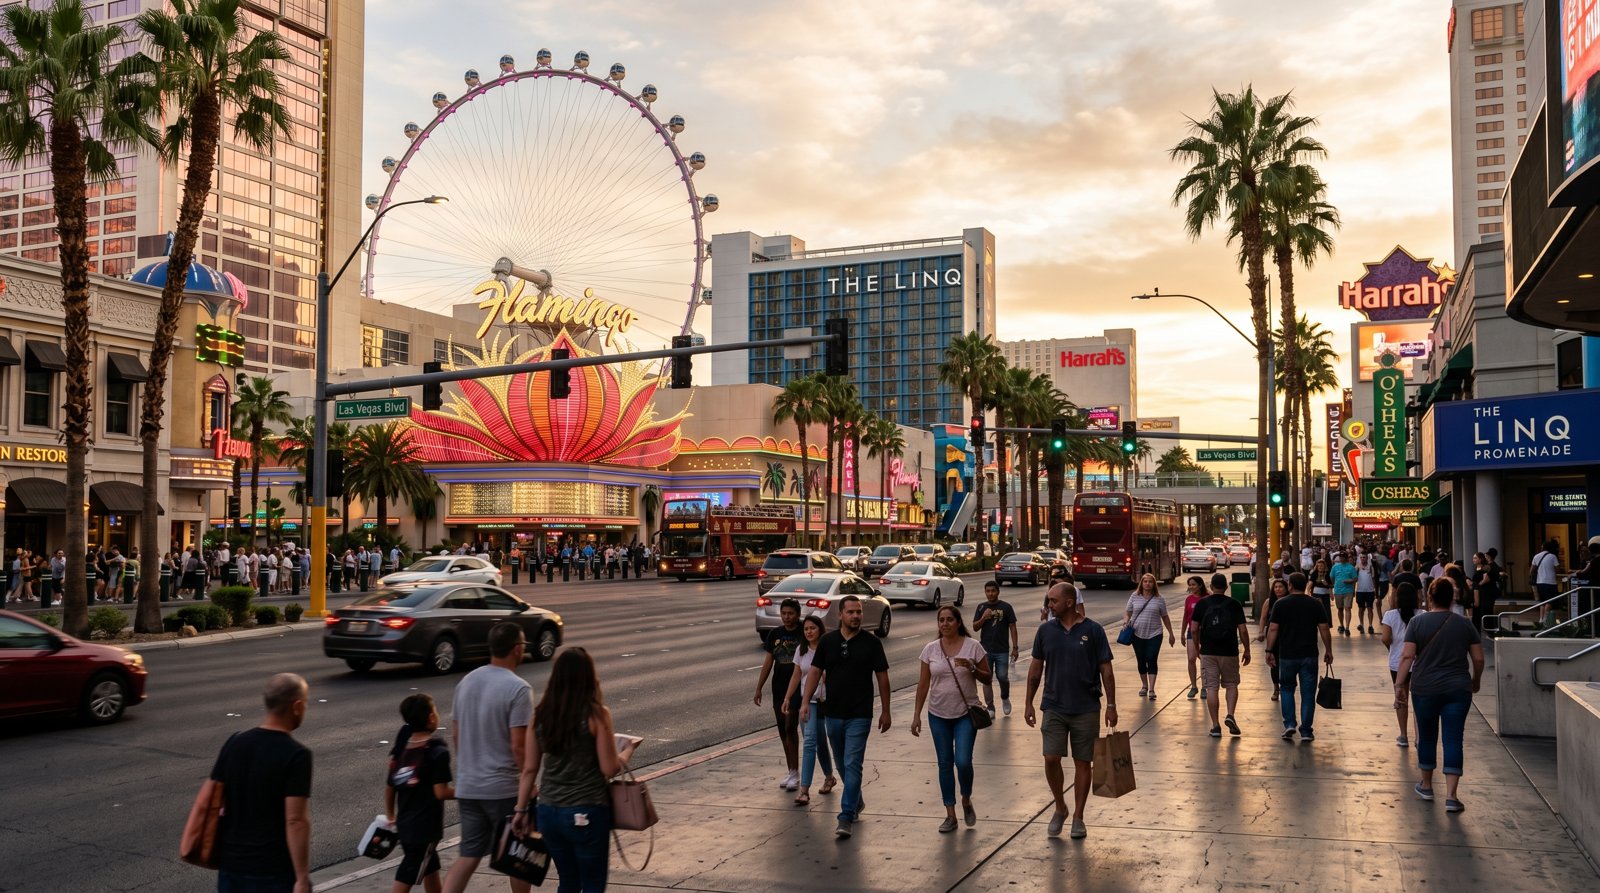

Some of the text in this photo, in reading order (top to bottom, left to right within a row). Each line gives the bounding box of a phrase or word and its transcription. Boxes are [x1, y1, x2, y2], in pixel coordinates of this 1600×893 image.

[827, 268, 961, 294] THE LINQ
[472, 278, 639, 347] Flamingo
[338, 401, 405, 417] Las Vegas Blvd
[1473, 406, 1501, 418] THE
[1380, 374, 1400, 473] O'SHEAS
[1474, 415, 1571, 445] LINQ
[1198, 451, 1255, 460] Las Vegas Blvd
[1474, 444, 1572, 460] PROMENADE
[1371, 485, 1430, 500] O'SHEAS
